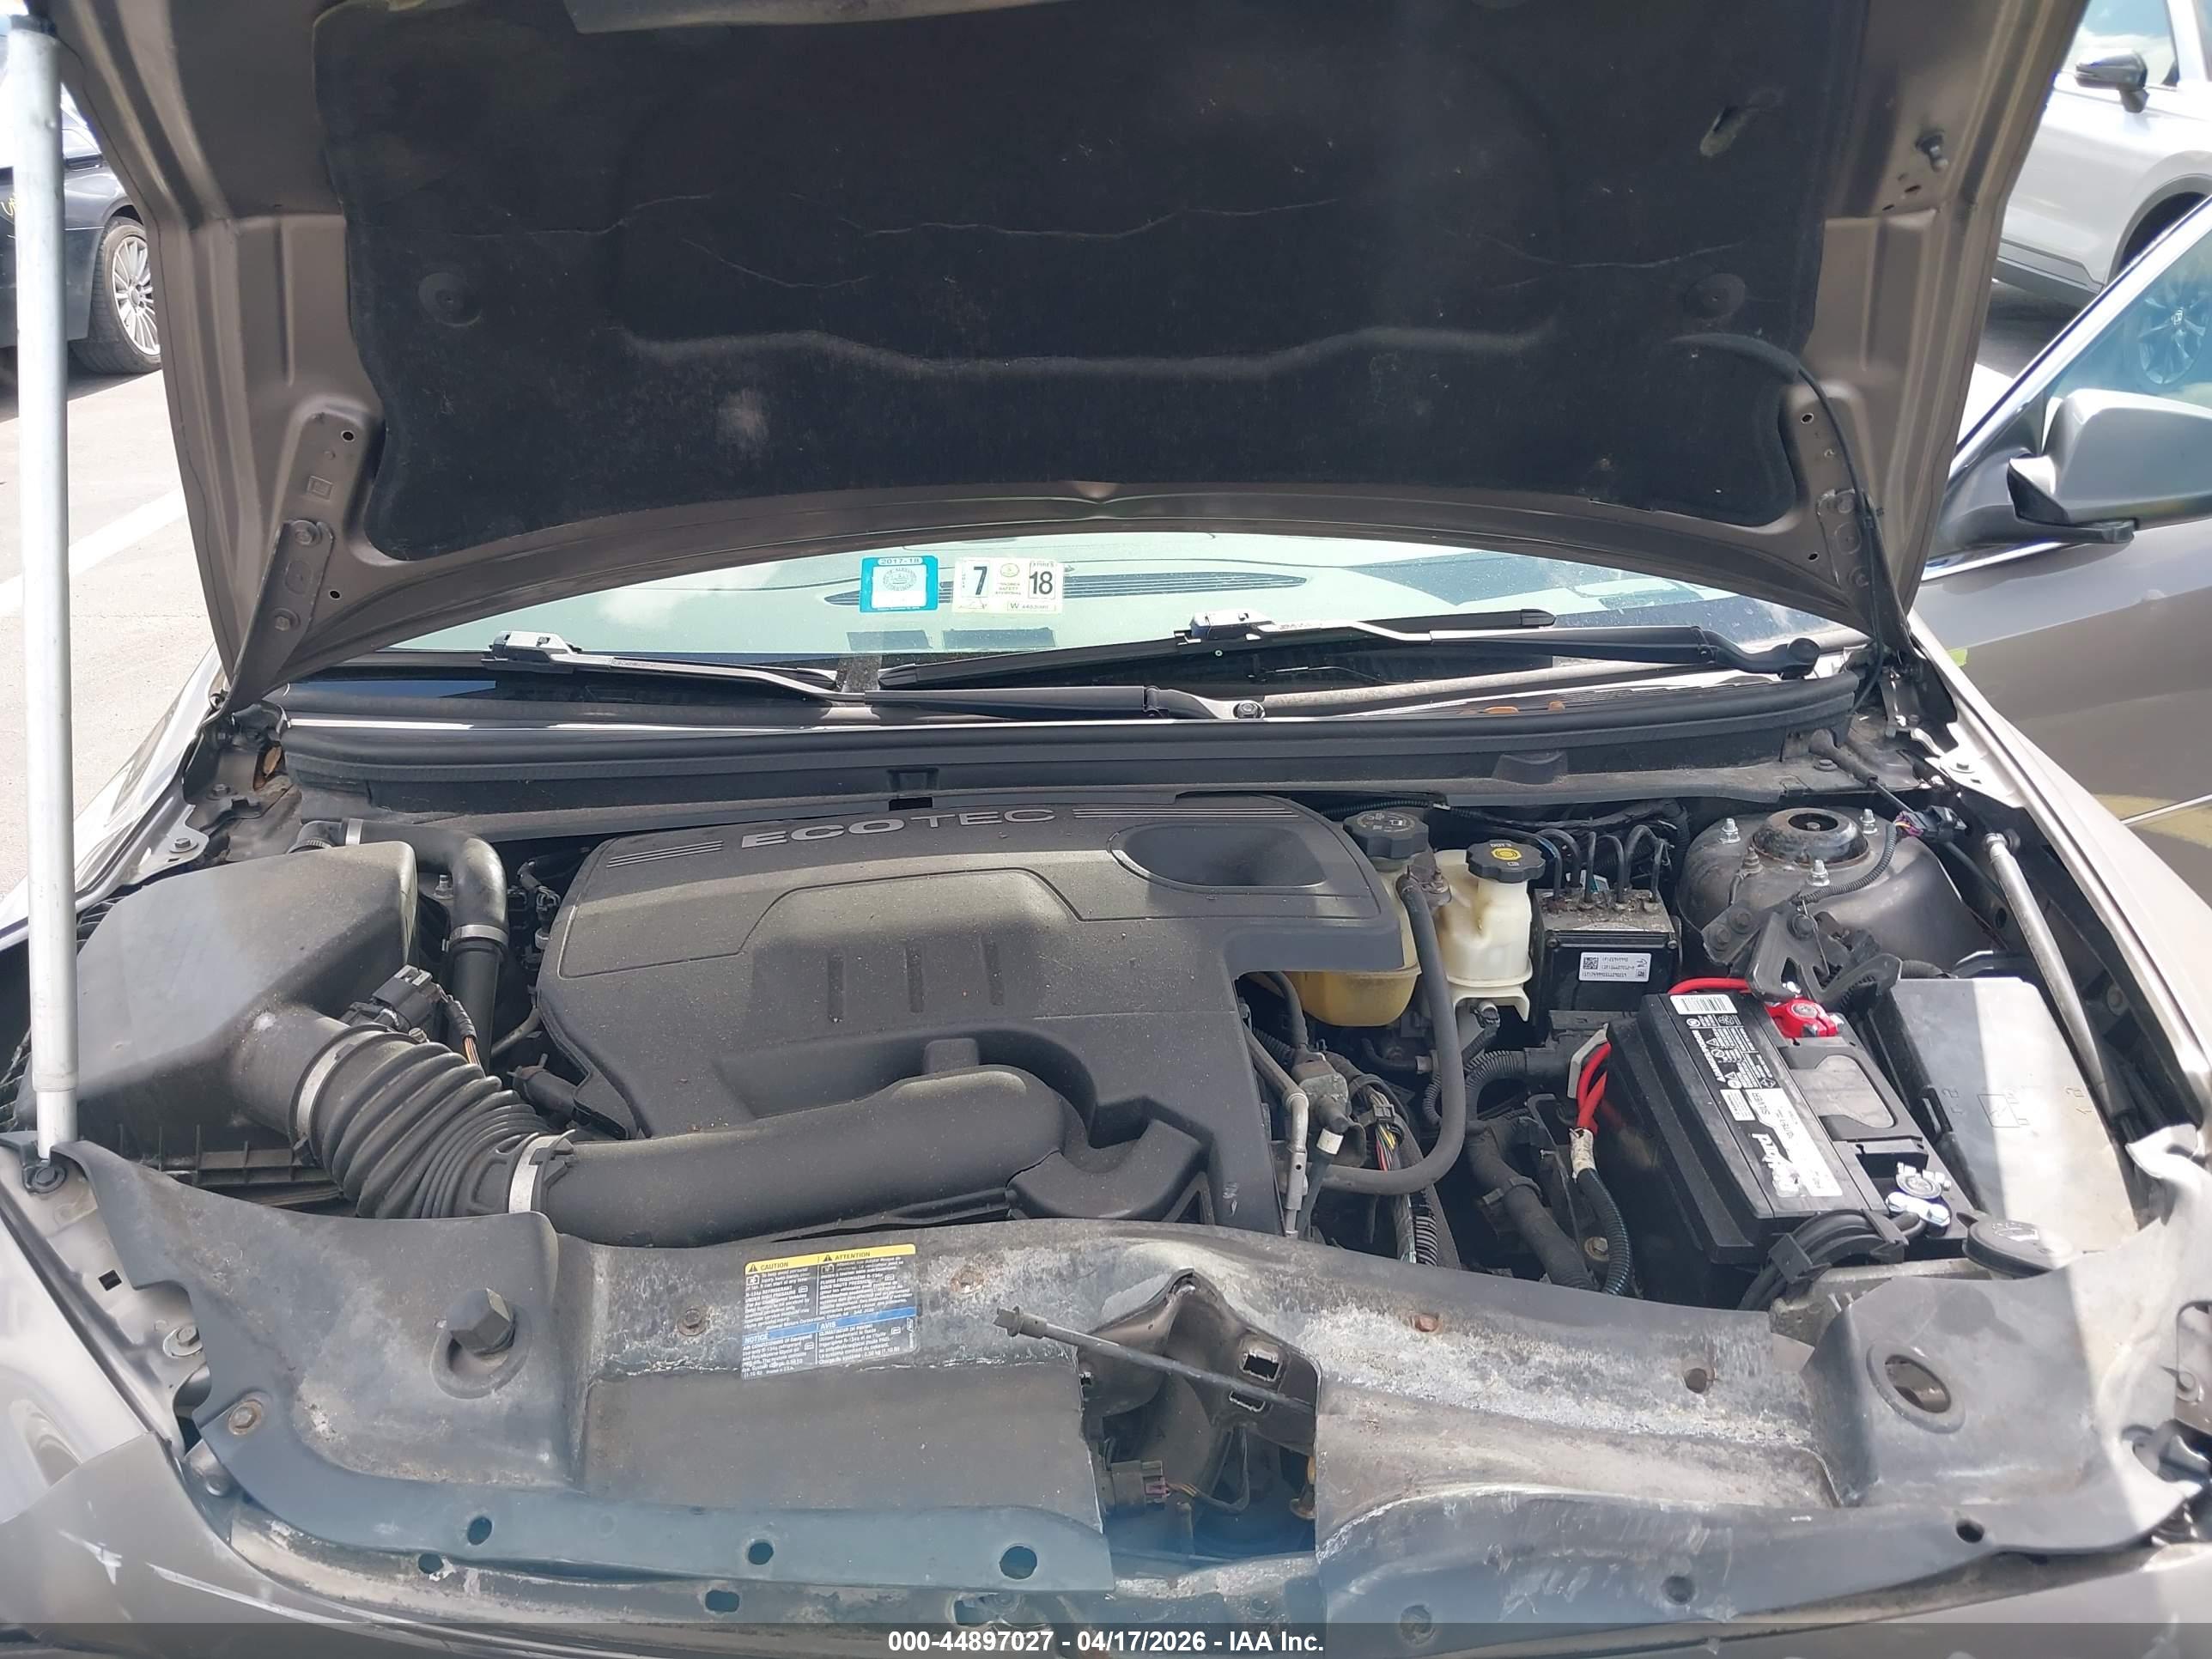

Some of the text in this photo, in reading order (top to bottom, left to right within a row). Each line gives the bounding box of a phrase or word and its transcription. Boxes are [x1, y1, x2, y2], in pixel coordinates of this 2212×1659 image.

[973, 566, 988, 596] 7
[1029, 570, 1054, 595] 18
[741, 808, 1057, 849] ECOTEC
[1752, 1091, 1771, 1115] SILVER
[835, 1251, 871, 1261] ATTENTION
[760, 1261, 789, 1271] CAUTION
[820, 1321, 836, 1330] AVIS
[744, 1334, 769, 1344] NOTICE
